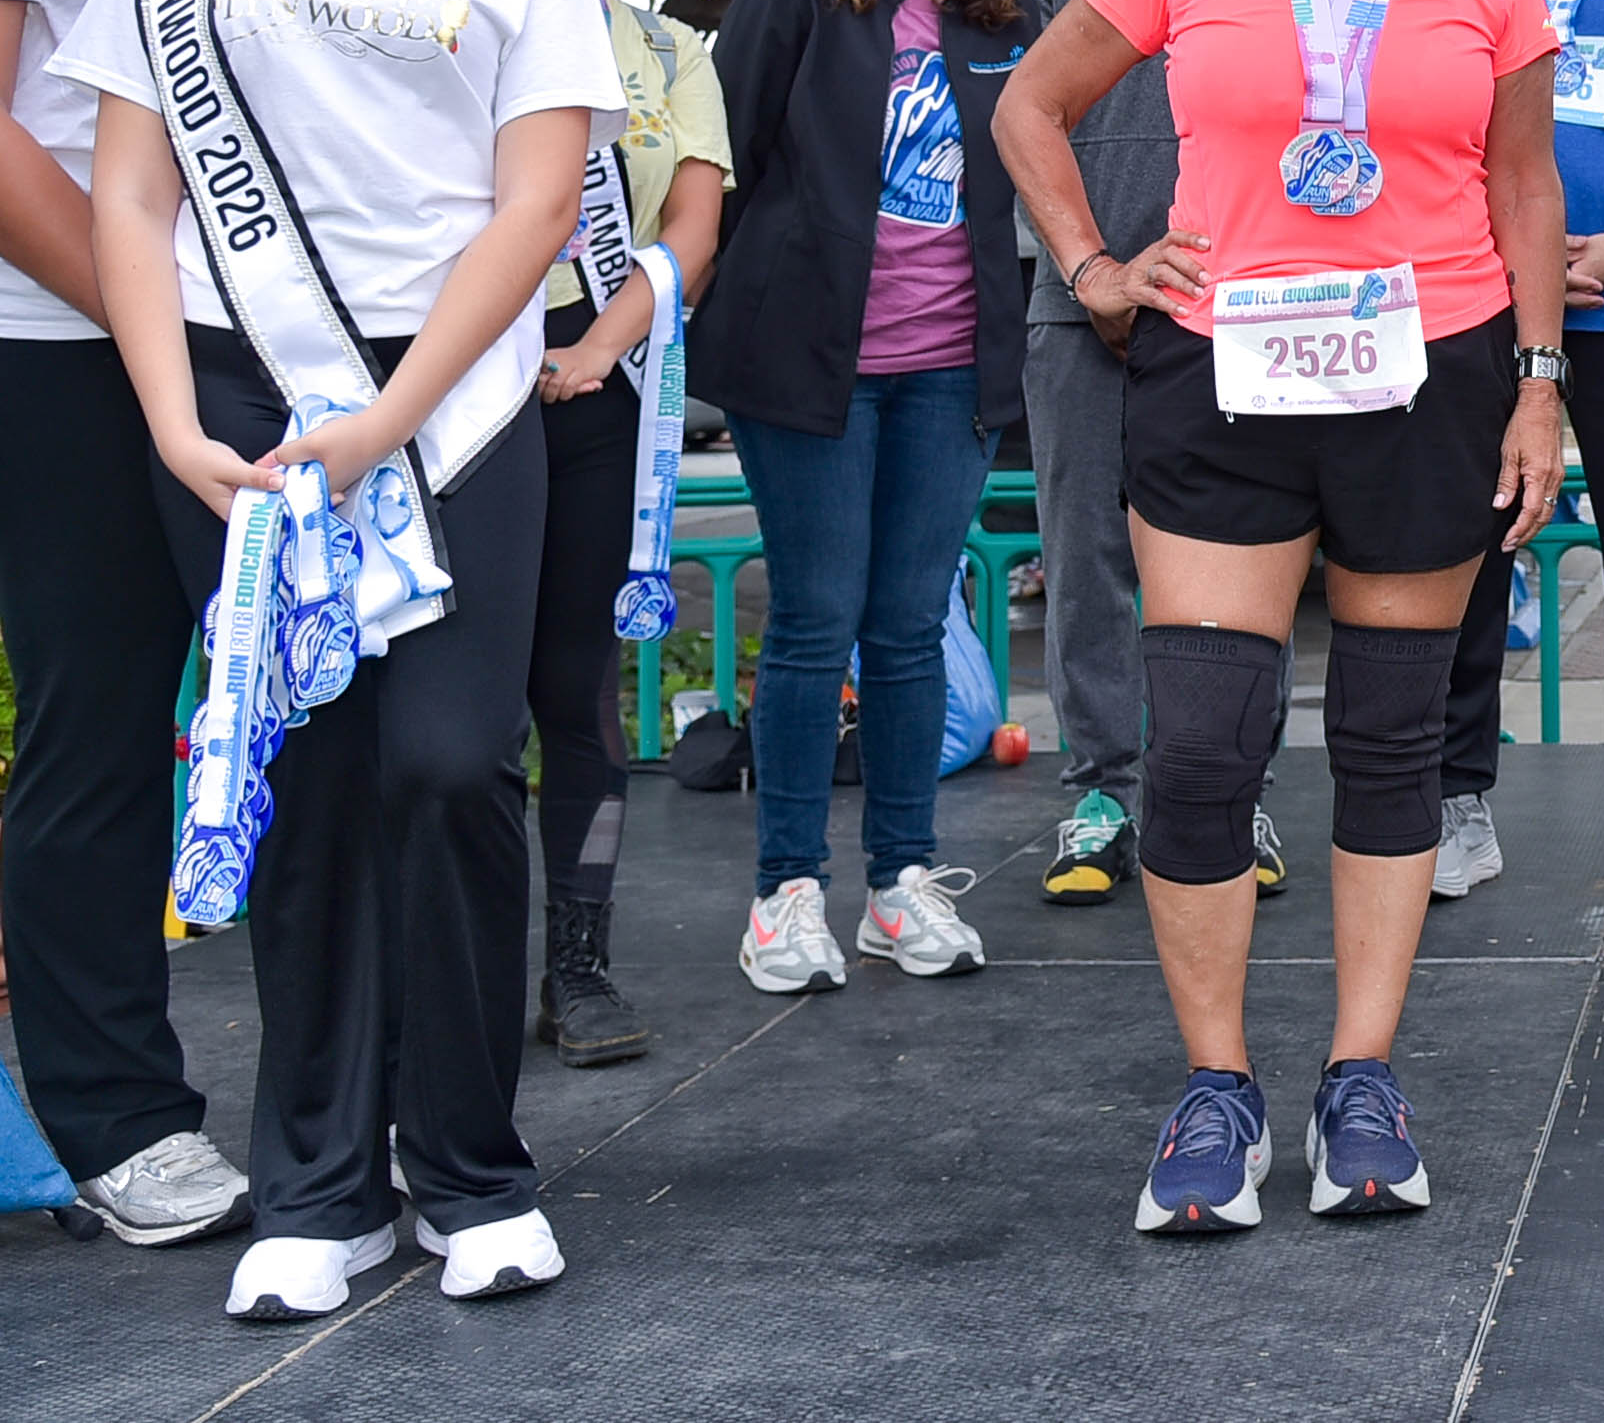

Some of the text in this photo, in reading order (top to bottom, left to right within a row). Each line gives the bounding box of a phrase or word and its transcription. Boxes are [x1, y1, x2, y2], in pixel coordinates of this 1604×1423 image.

[1345, 0, 1374, 27] RUN
[197, 134, 278, 252] 2026
[902, 178, 951, 207] RUN
[1306, 187, 1329, 197] RUN
[881, 199, 951, 222] OR WALK
[1264, 330, 1378, 378] 2526
[658, 344, 677, 417] EDUCATION
[653, 450, 673, 477] RUN
[226, 503, 273, 694] RUN FOR EDUCATION
